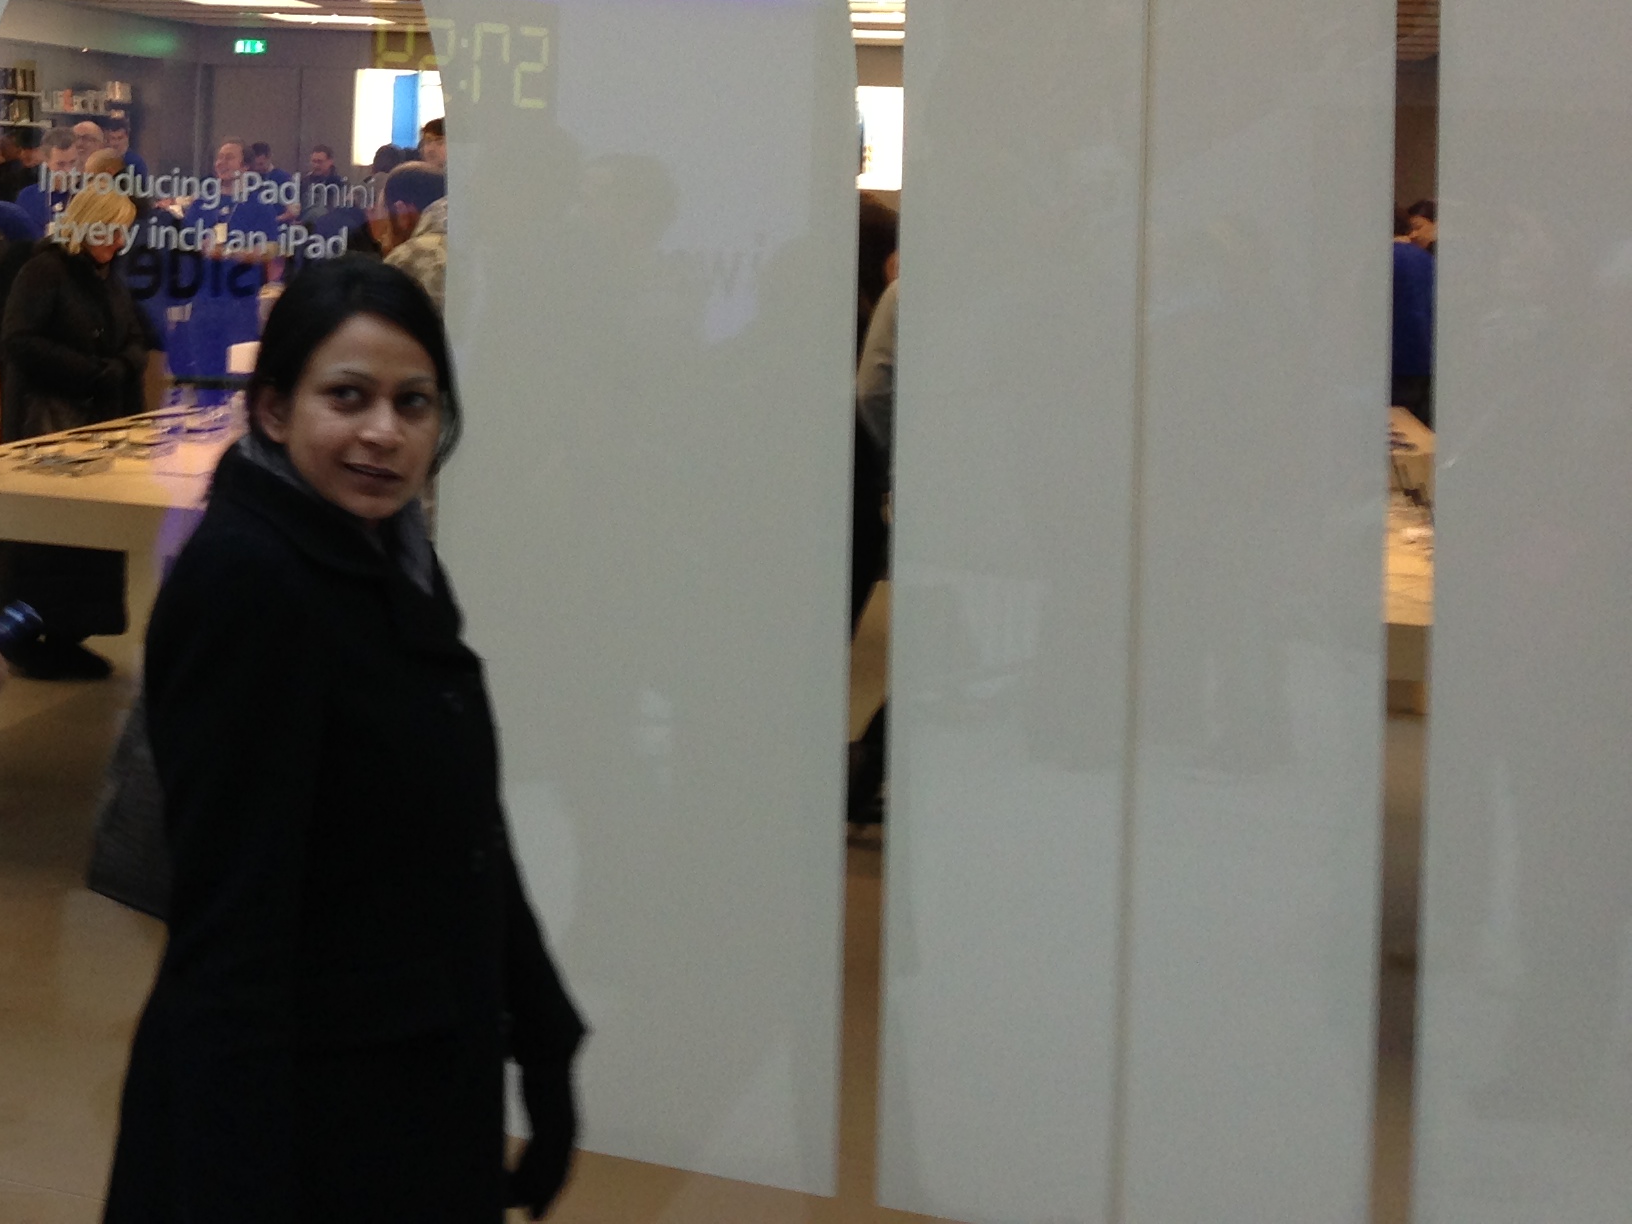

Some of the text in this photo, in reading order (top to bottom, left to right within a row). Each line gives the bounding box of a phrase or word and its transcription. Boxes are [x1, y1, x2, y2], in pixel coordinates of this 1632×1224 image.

[38, 162, 375, 210] Introducing iPad mini
[52, 212, 348, 260] Every inch an iPad
